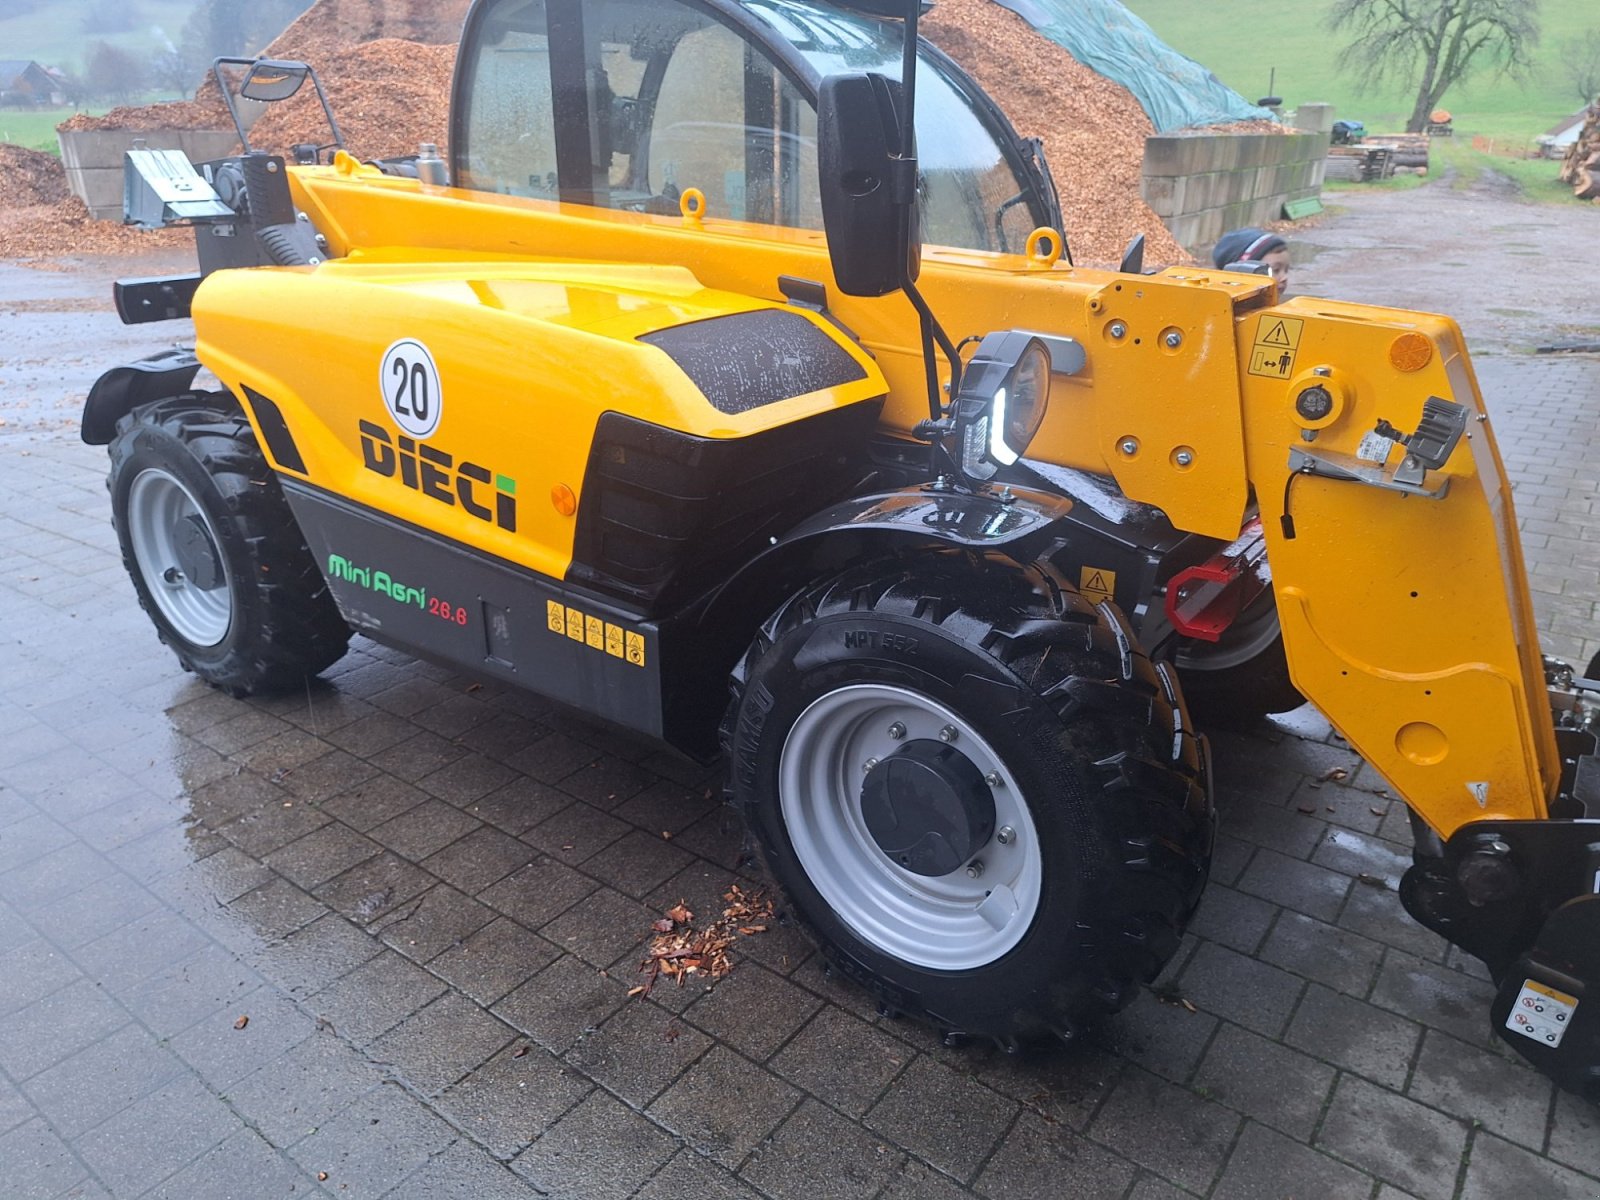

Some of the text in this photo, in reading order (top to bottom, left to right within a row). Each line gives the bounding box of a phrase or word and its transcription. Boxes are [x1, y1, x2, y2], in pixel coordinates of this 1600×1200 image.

[392, 357, 428, 421] 20
[329, 554, 370, 588] Mini
[429, 597, 467, 625] 26.6
[844, 630, 877, 649] MPT
